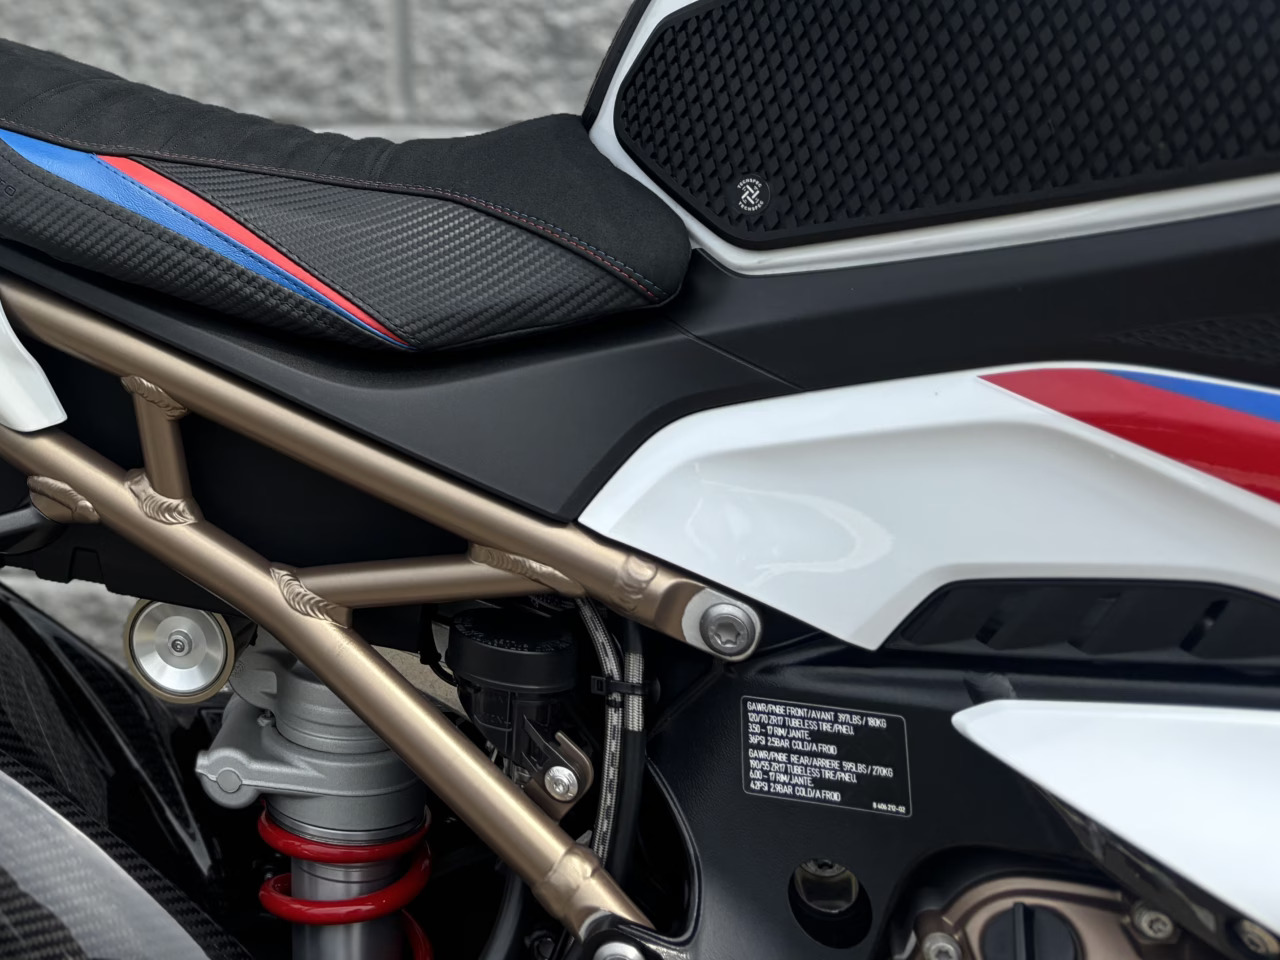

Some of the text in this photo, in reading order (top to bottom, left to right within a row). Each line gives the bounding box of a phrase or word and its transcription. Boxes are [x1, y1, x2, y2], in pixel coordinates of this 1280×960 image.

[737, 178, 762, 189] TECHSPEC
[738, 200, 764, 211] TECHSPEC
[746, 701, 786, 715] GAWR/PNBE
[786, 707, 835, 721] FRONT/AVANT
[748, 712, 768, 724] 120/70
[769, 715, 784, 726] ZR17
[784, 717, 818, 730] TUBELESS
[766, 726, 773, 735] 17
[748, 734, 766, 745] 36PSI
[818, 743, 838, 755] FROID
[748, 748, 789, 762] GAWR/PNBE
[790, 754, 840, 770] REAR/ARRIERE
[842, 761, 867, 774] 595LBS
[872, 765, 894, 778] 270KG
[749, 759, 770, 771] 190/55
[770, 762, 785, 772] ZR17
[787, 764, 820, 777] TUBELESS
[768, 772, 775, 781] 17
[750, 780, 768, 791] 42PSI
[770, 783, 793, 795] 2.9BAR
[821, 790, 841, 801] FROID
